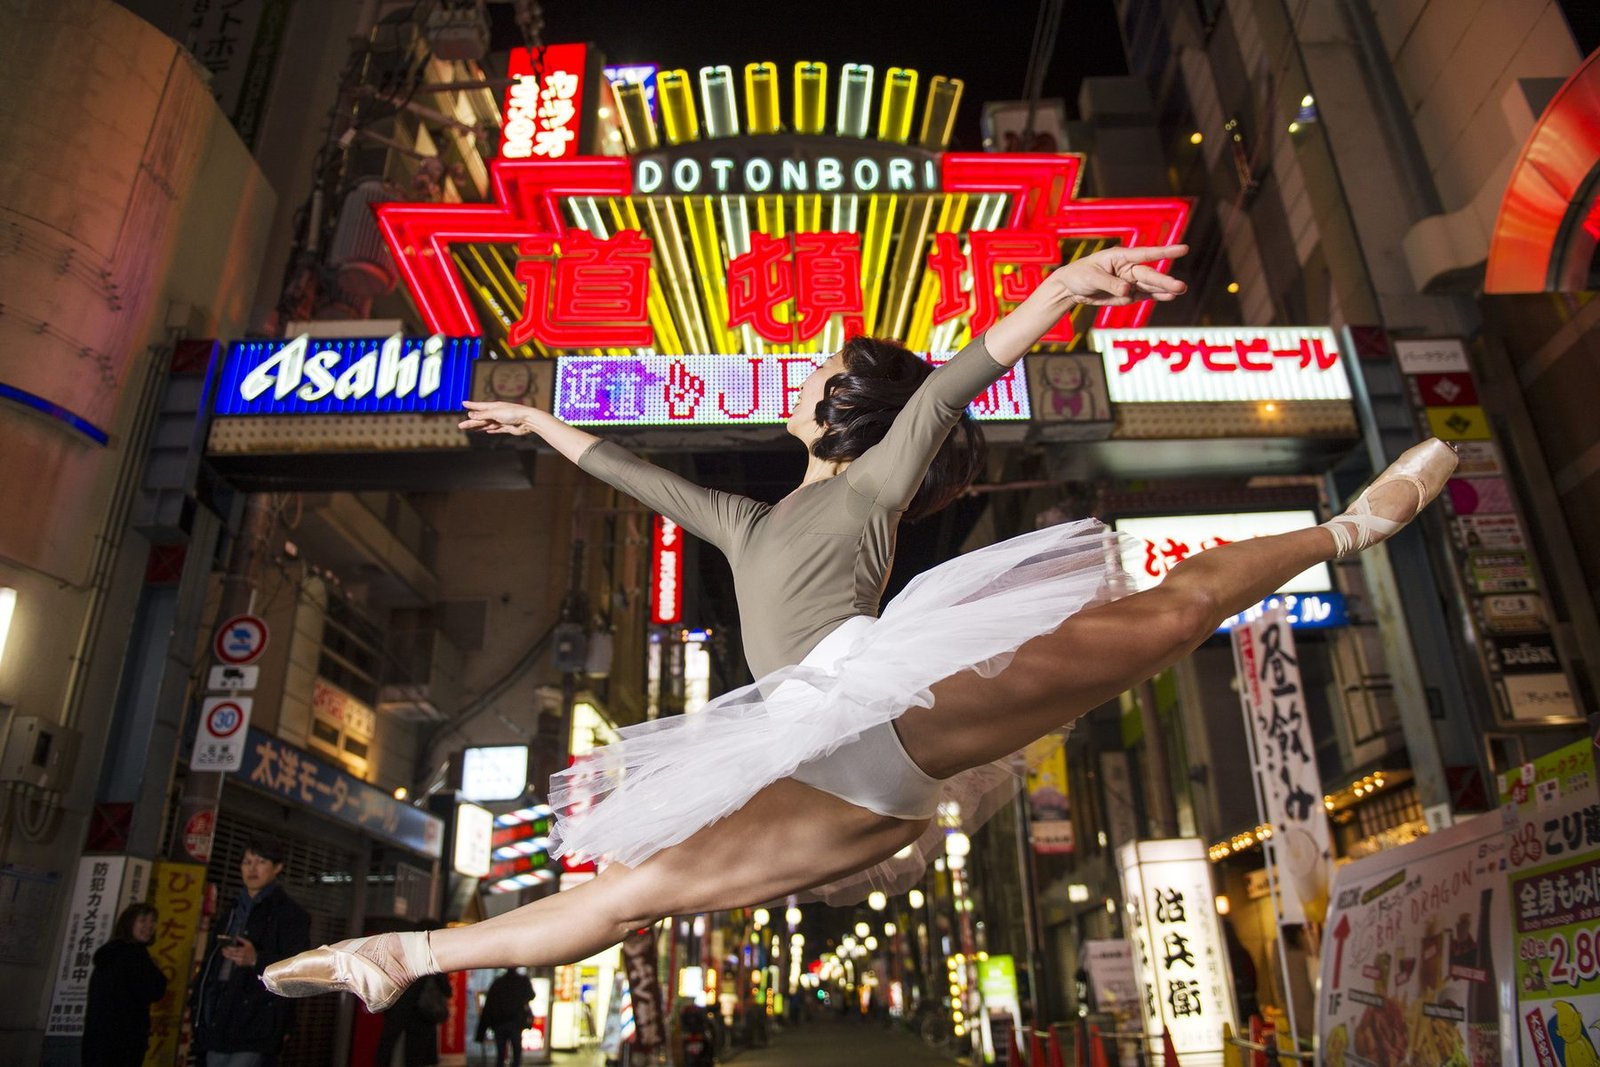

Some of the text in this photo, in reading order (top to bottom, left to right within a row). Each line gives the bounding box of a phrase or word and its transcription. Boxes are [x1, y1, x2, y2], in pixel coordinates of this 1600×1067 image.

[637, 157, 937, 194] DOTONBORI
[508, 228, 1074, 348] 道頓堀
[239, 332, 446, 402] Asahi
[1112, 337, 1340, 375] アサヒビール
[214, 711, 236, 730] 30
[1375, 911, 1403, 948] BAR
[1410, 859, 1474, 925] DRAGON
